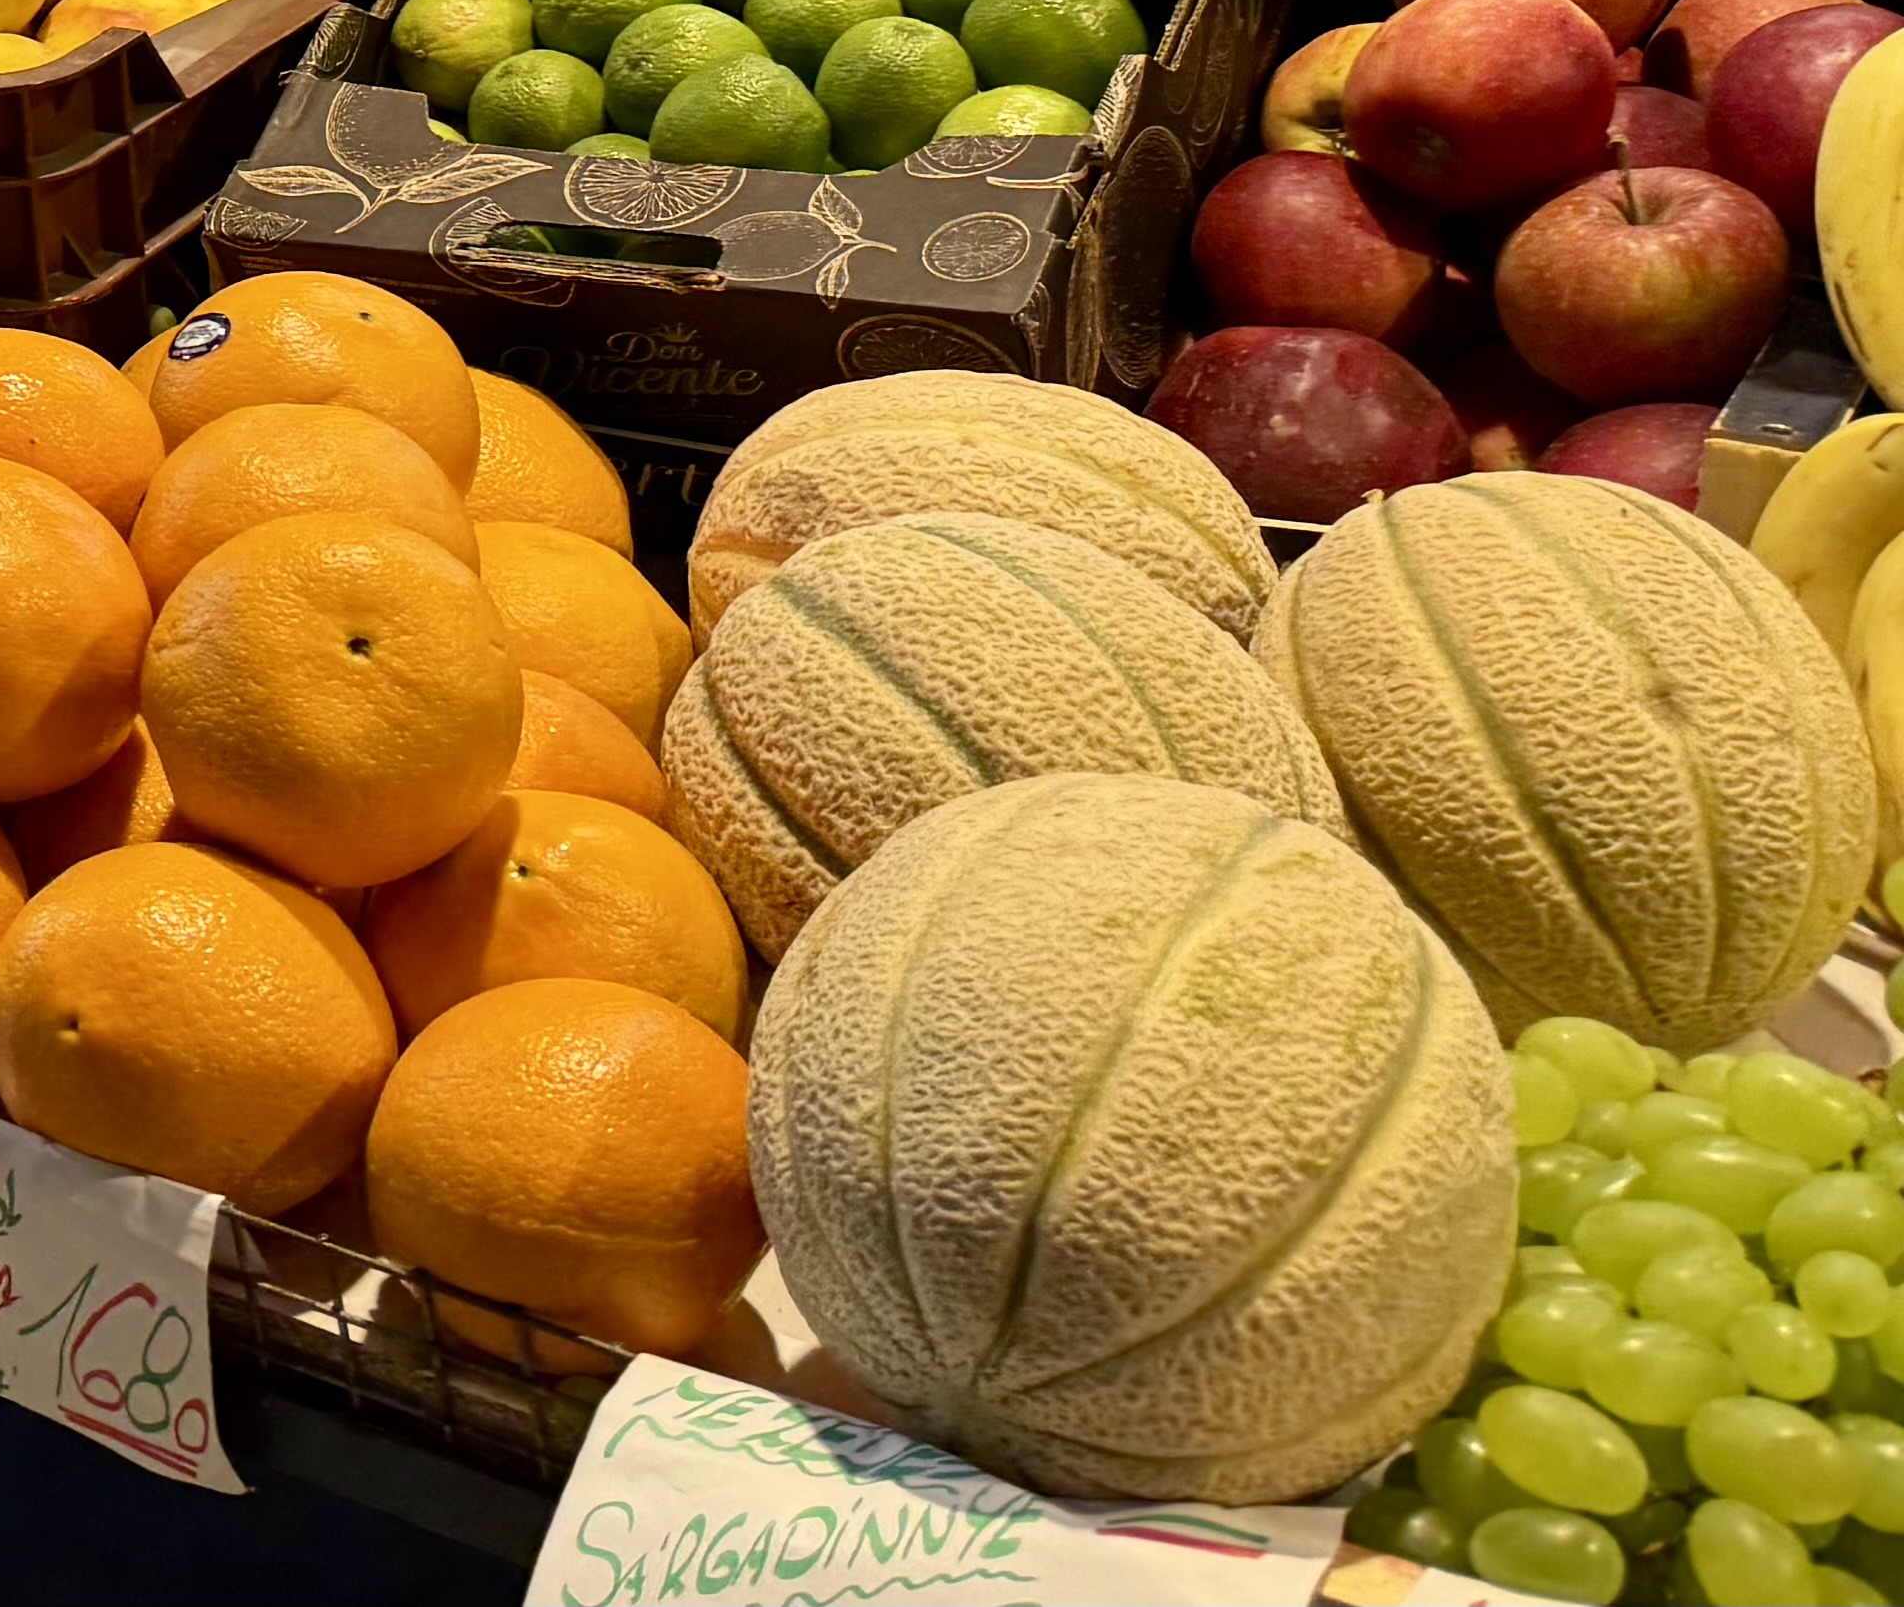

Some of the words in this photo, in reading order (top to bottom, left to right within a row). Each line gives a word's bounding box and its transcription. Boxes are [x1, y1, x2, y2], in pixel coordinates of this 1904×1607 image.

[498, 344, 767, 396] Vicente
[604, 330, 703, 363] Don
[17, 1263, 211, 1454] 1680
